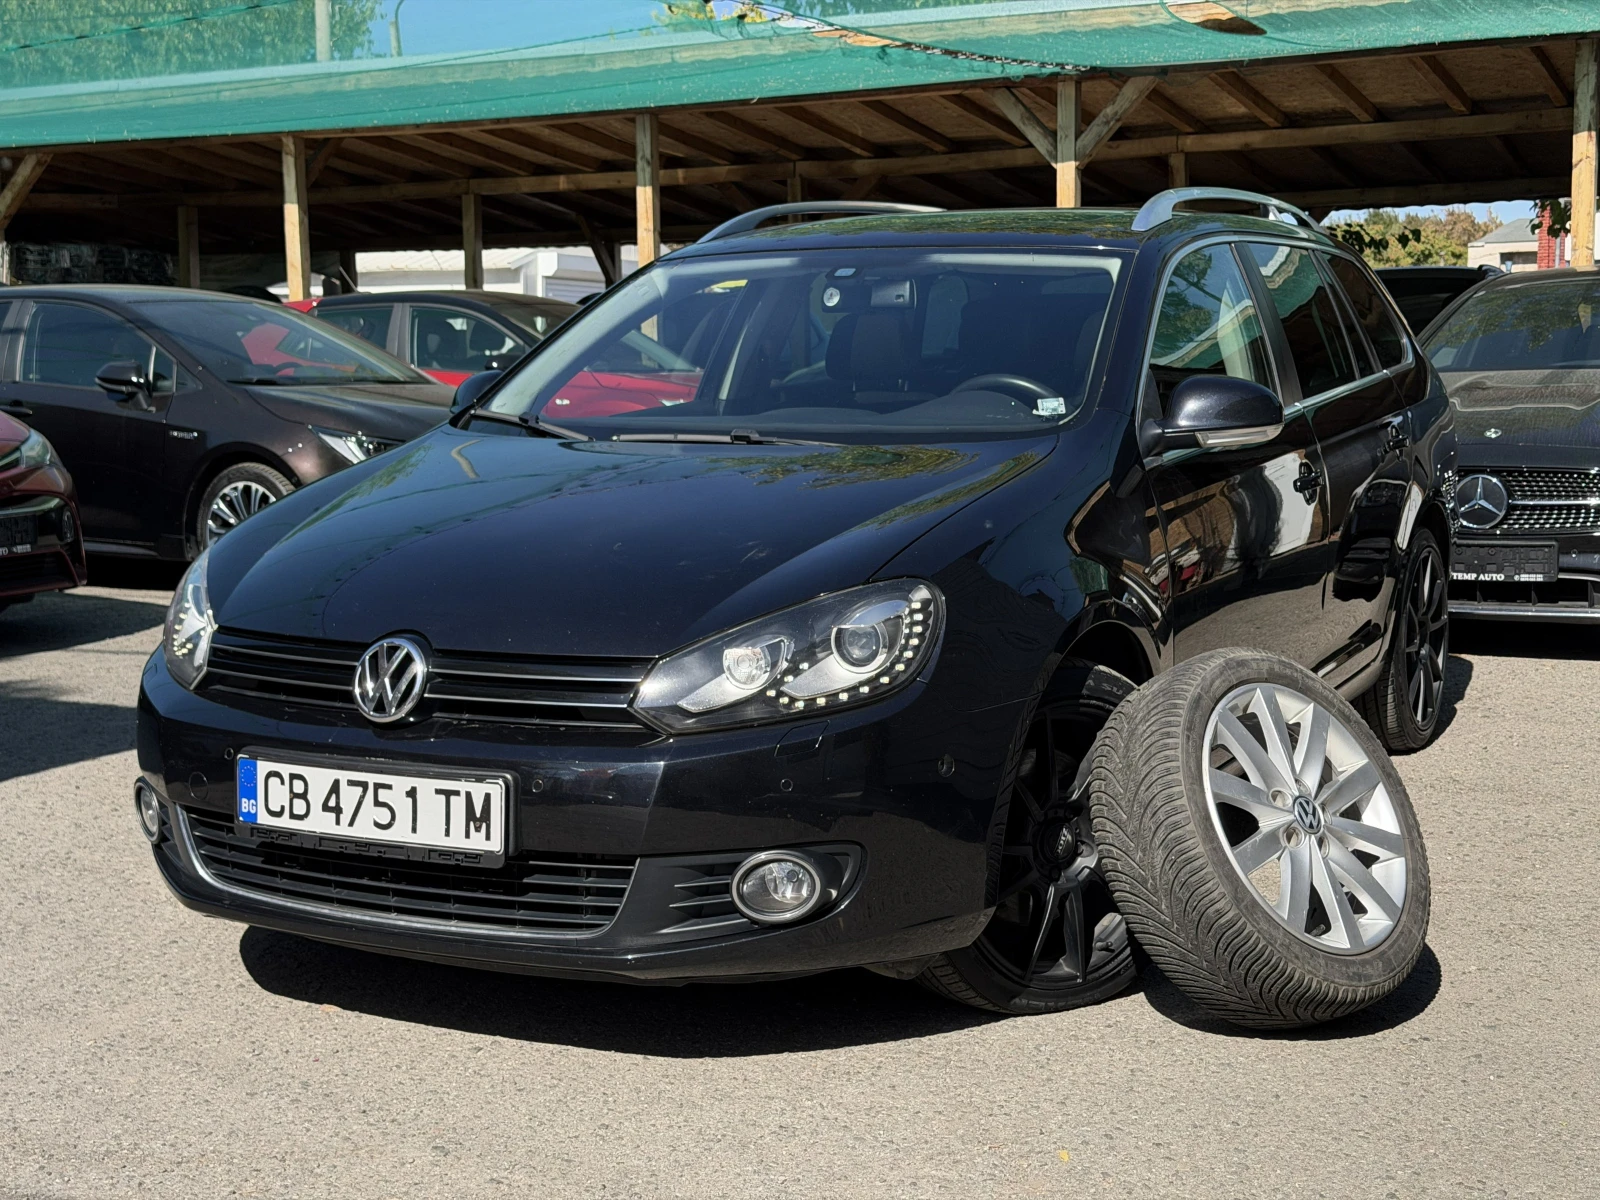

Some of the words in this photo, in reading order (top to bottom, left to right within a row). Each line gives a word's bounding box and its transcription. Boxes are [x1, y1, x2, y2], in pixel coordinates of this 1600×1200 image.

[1453, 573, 1477, 581] TEMP
[1479, 573, 1504, 581] AUTO
[241, 798, 257, 814] BG
[263, 769, 311, 821] CB
[321, 777, 418, 834] 4751
[434, 788, 492, 842] TM
